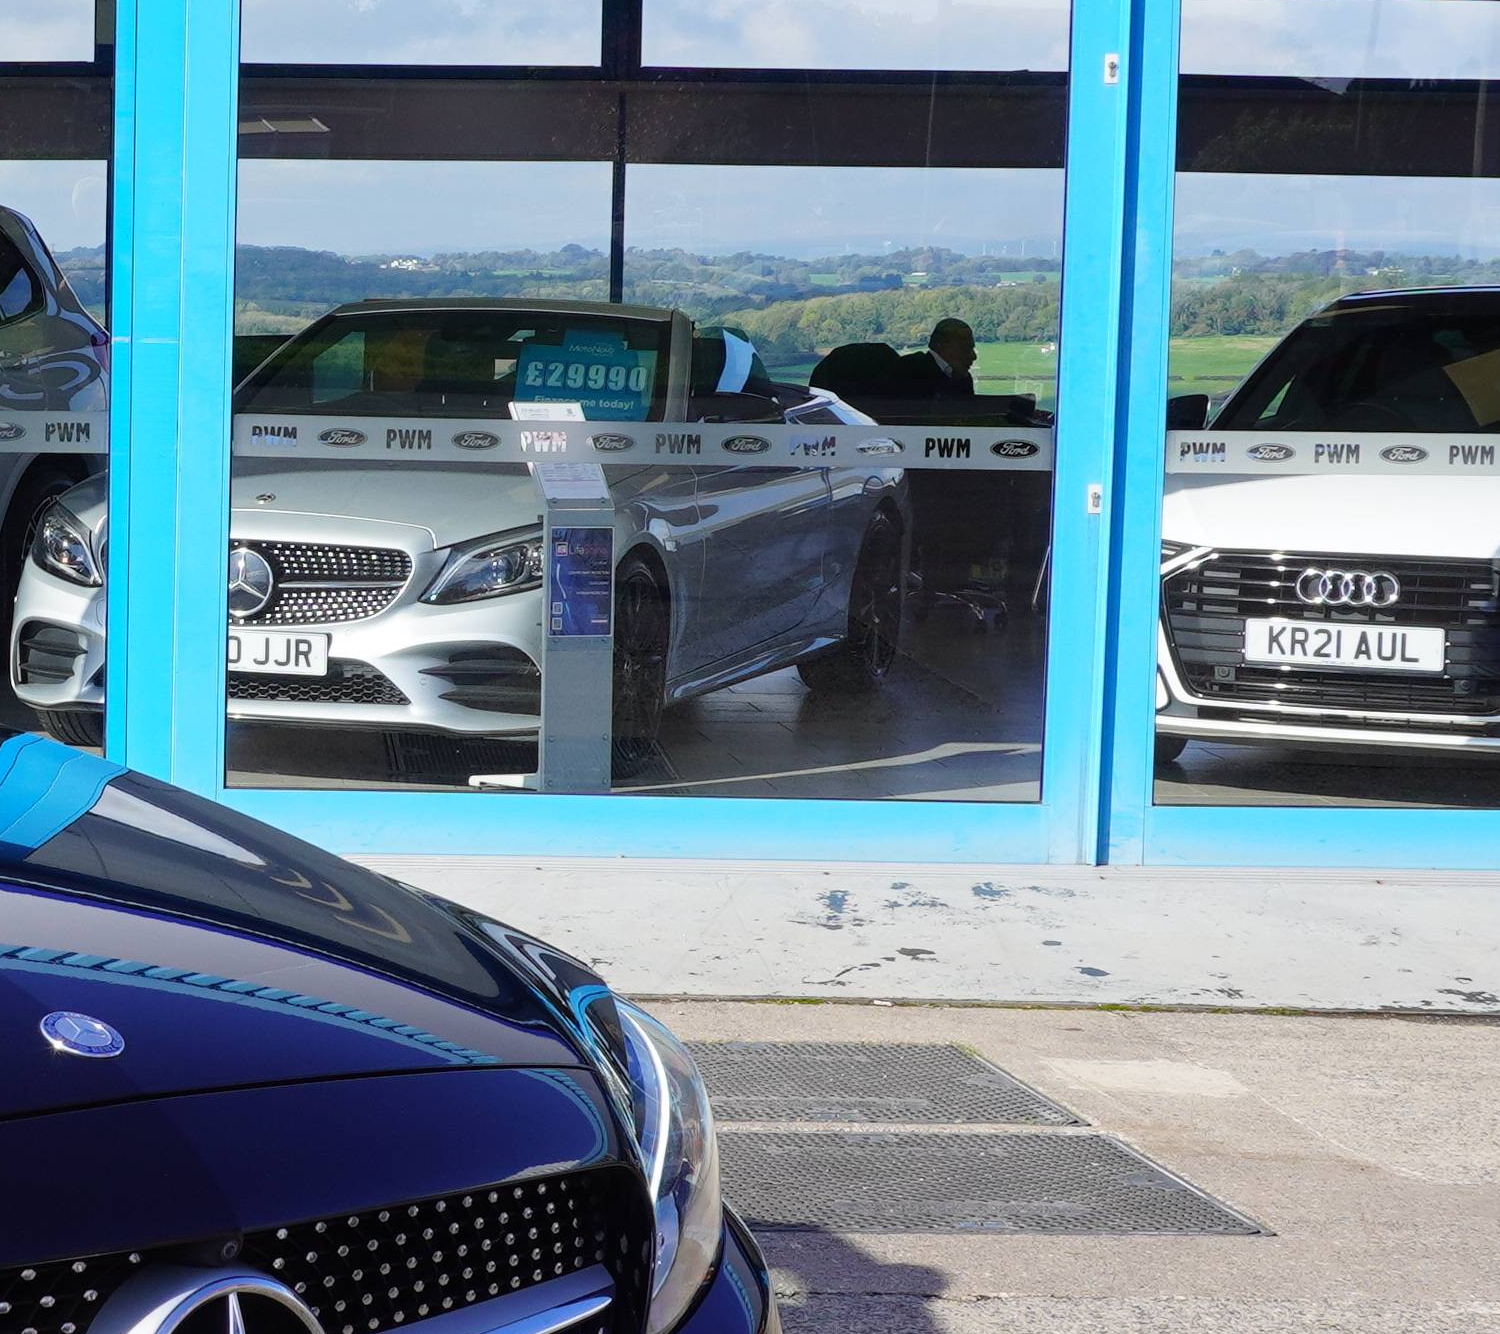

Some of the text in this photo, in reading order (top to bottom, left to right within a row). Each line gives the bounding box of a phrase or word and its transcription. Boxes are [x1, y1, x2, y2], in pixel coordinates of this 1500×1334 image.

[525, 361, 648, 392] £29990
[599, 399, 634, 411] today!
[45, 422, 91, 443] PWM
[323, 429, 363, 446] Ford
[386, 429, 432, 450] PWM
[456, 432, 496, 449] Ford
[655, 433, 701, 455] PWM
[726, 436, 767, 453] Ford
[924, 438, 971, 459] PWM
[995, 440, 1036, 458] Ford
[1251, 444, 1291, 461] Ford
[1314, 443, 1360, 465] PWM
[1384, 446, 1425, 463] Ford
[1449, 445, 1495, 466] PWM
[253, 636, 313, 668] JJR
[1267, 625, 1420, 663] KR21 AUL
